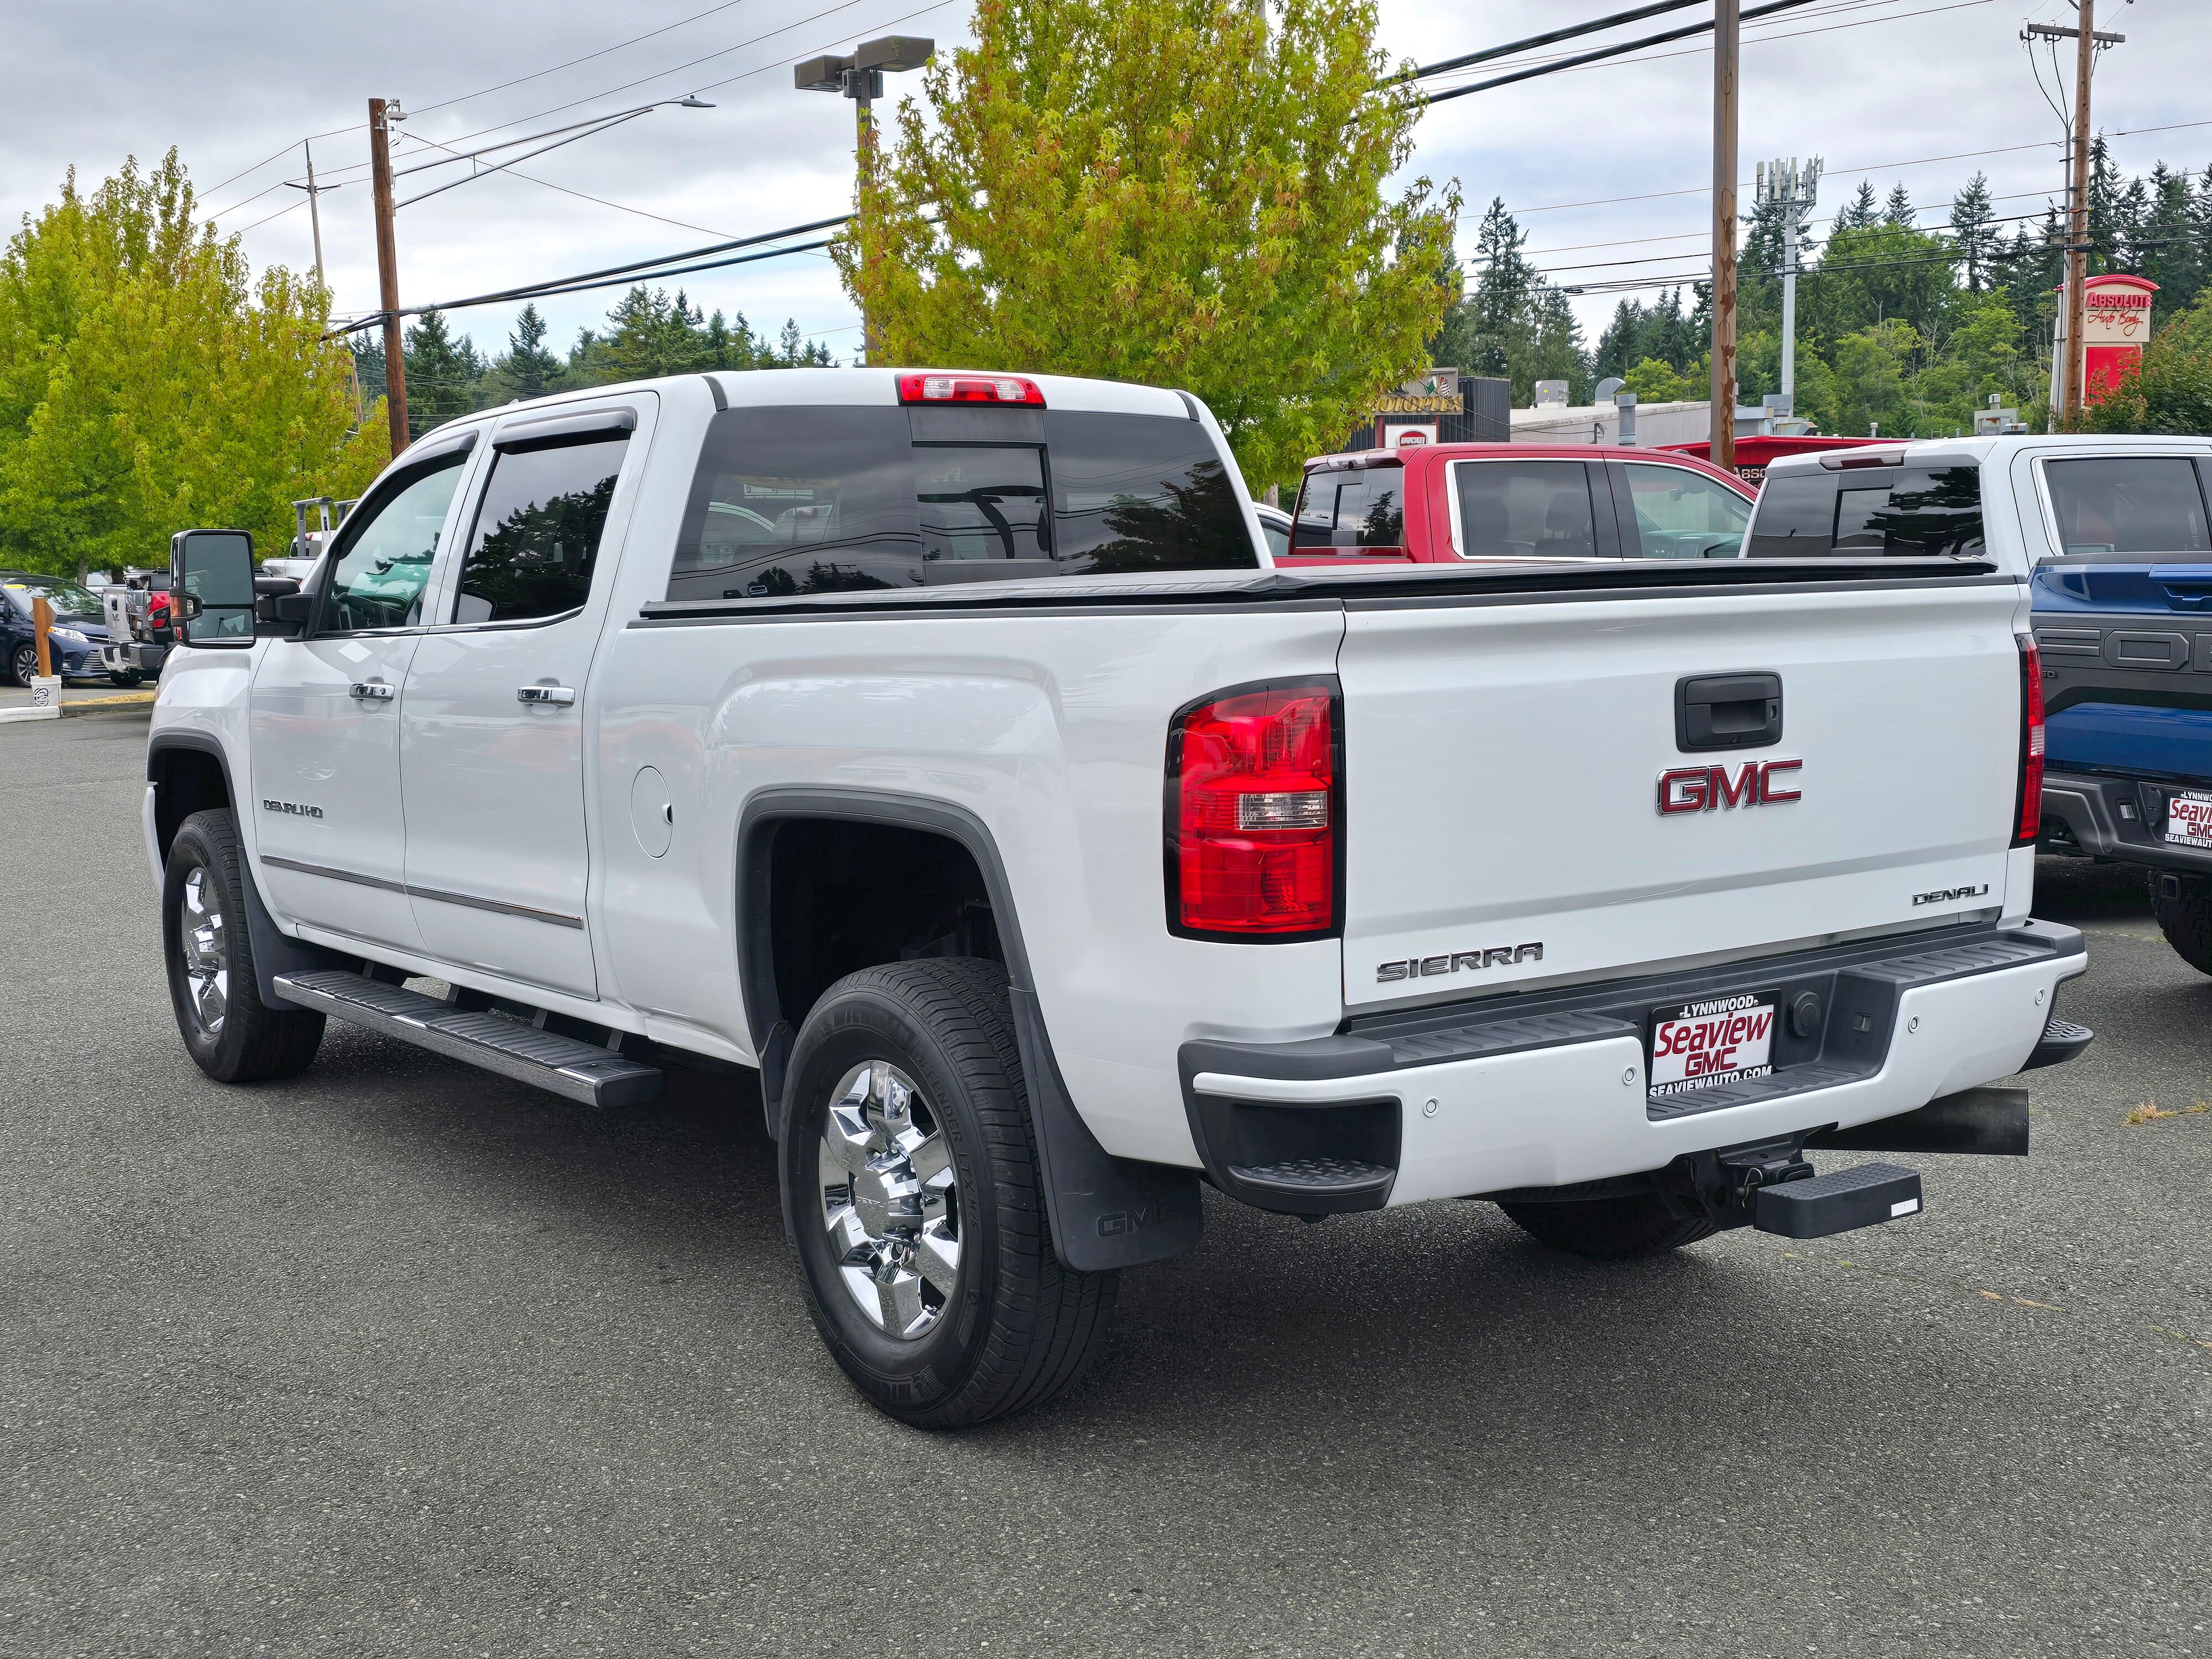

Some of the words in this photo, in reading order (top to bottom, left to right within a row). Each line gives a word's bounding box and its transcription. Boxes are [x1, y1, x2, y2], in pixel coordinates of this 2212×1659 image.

[2086, 292, 2152, 307] ABSOLUTE
[2032, 627, 2212, 673] FO
[1655, 757, 1803, 817] GMC
[263, 799, 305, 816] DENALI
[1912, 883, 1989, 906] DENALI
[1376, 941, 1543, 983] SIERRA
[1683, 995, 1754, 1018] LYNNWOOD
[1655, 1012, 1773, 1057] Seaview
[1685, 1046, 1738, 1077] GMC
[1649, 1065, 1772, 1098] SEAVIEWAUTO.COM
[1096, 1203, 1178, 1238] GM
